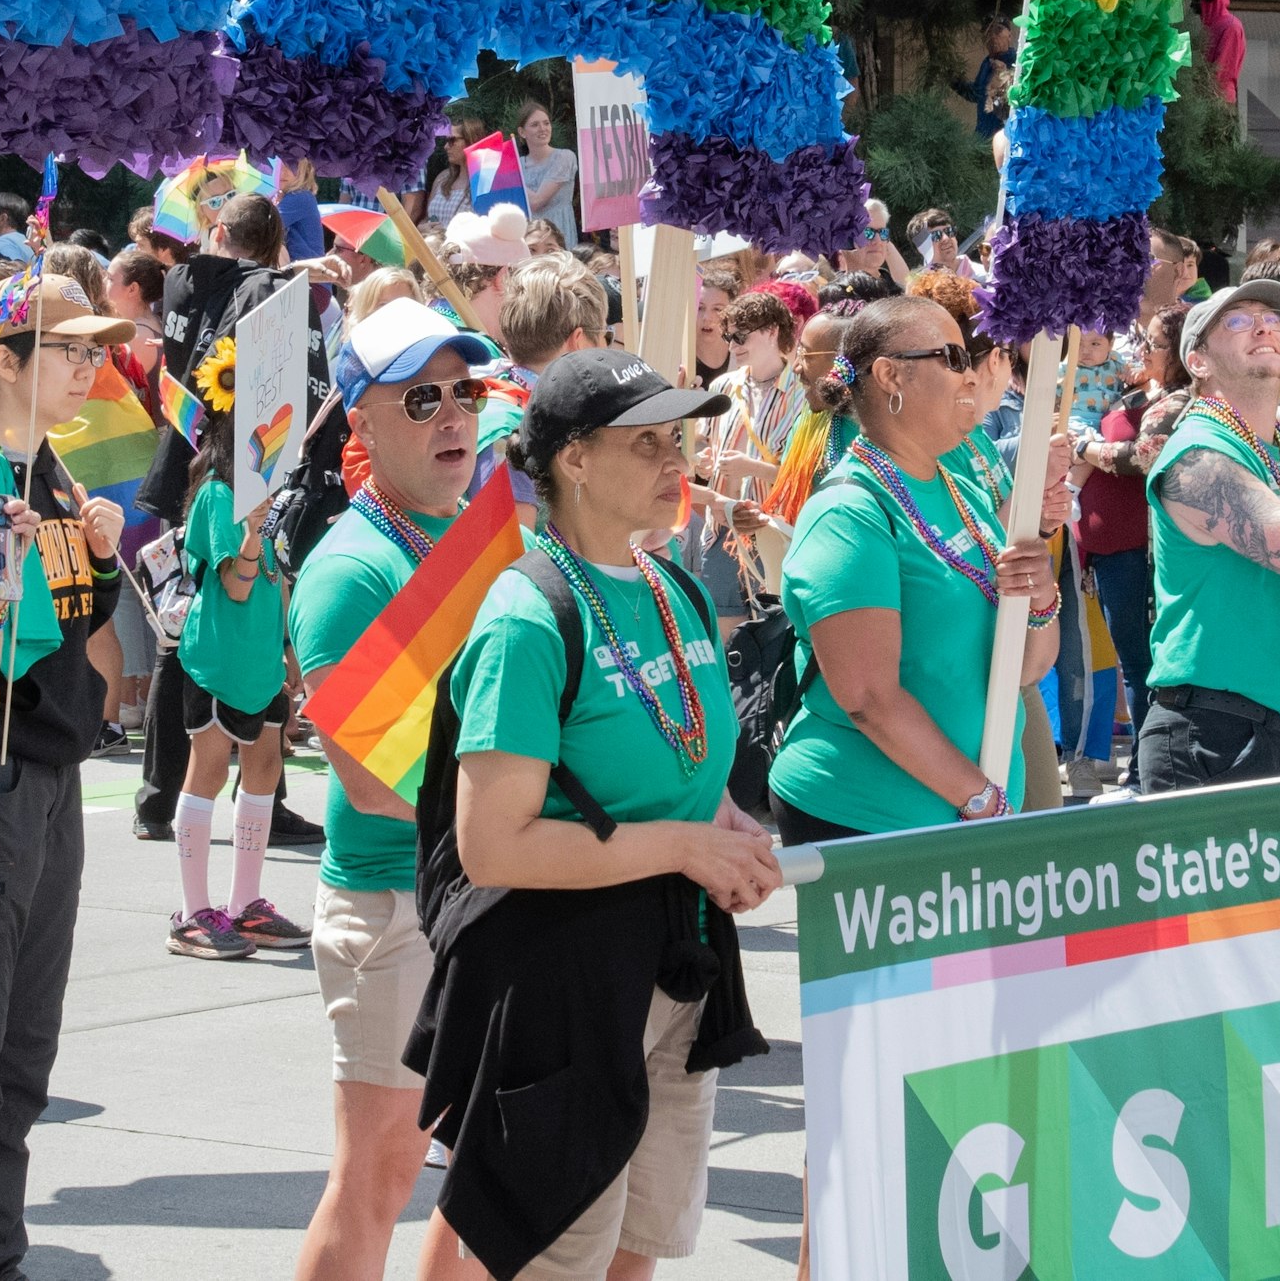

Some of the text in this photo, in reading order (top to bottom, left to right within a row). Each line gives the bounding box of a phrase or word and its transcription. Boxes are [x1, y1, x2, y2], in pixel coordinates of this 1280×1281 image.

[257, 367, 283, 419] BEST
[612, 363, 643, 384] Love
[834, 861, 1120, 954] Washington
[1135, 828, 1280, 903] State's
